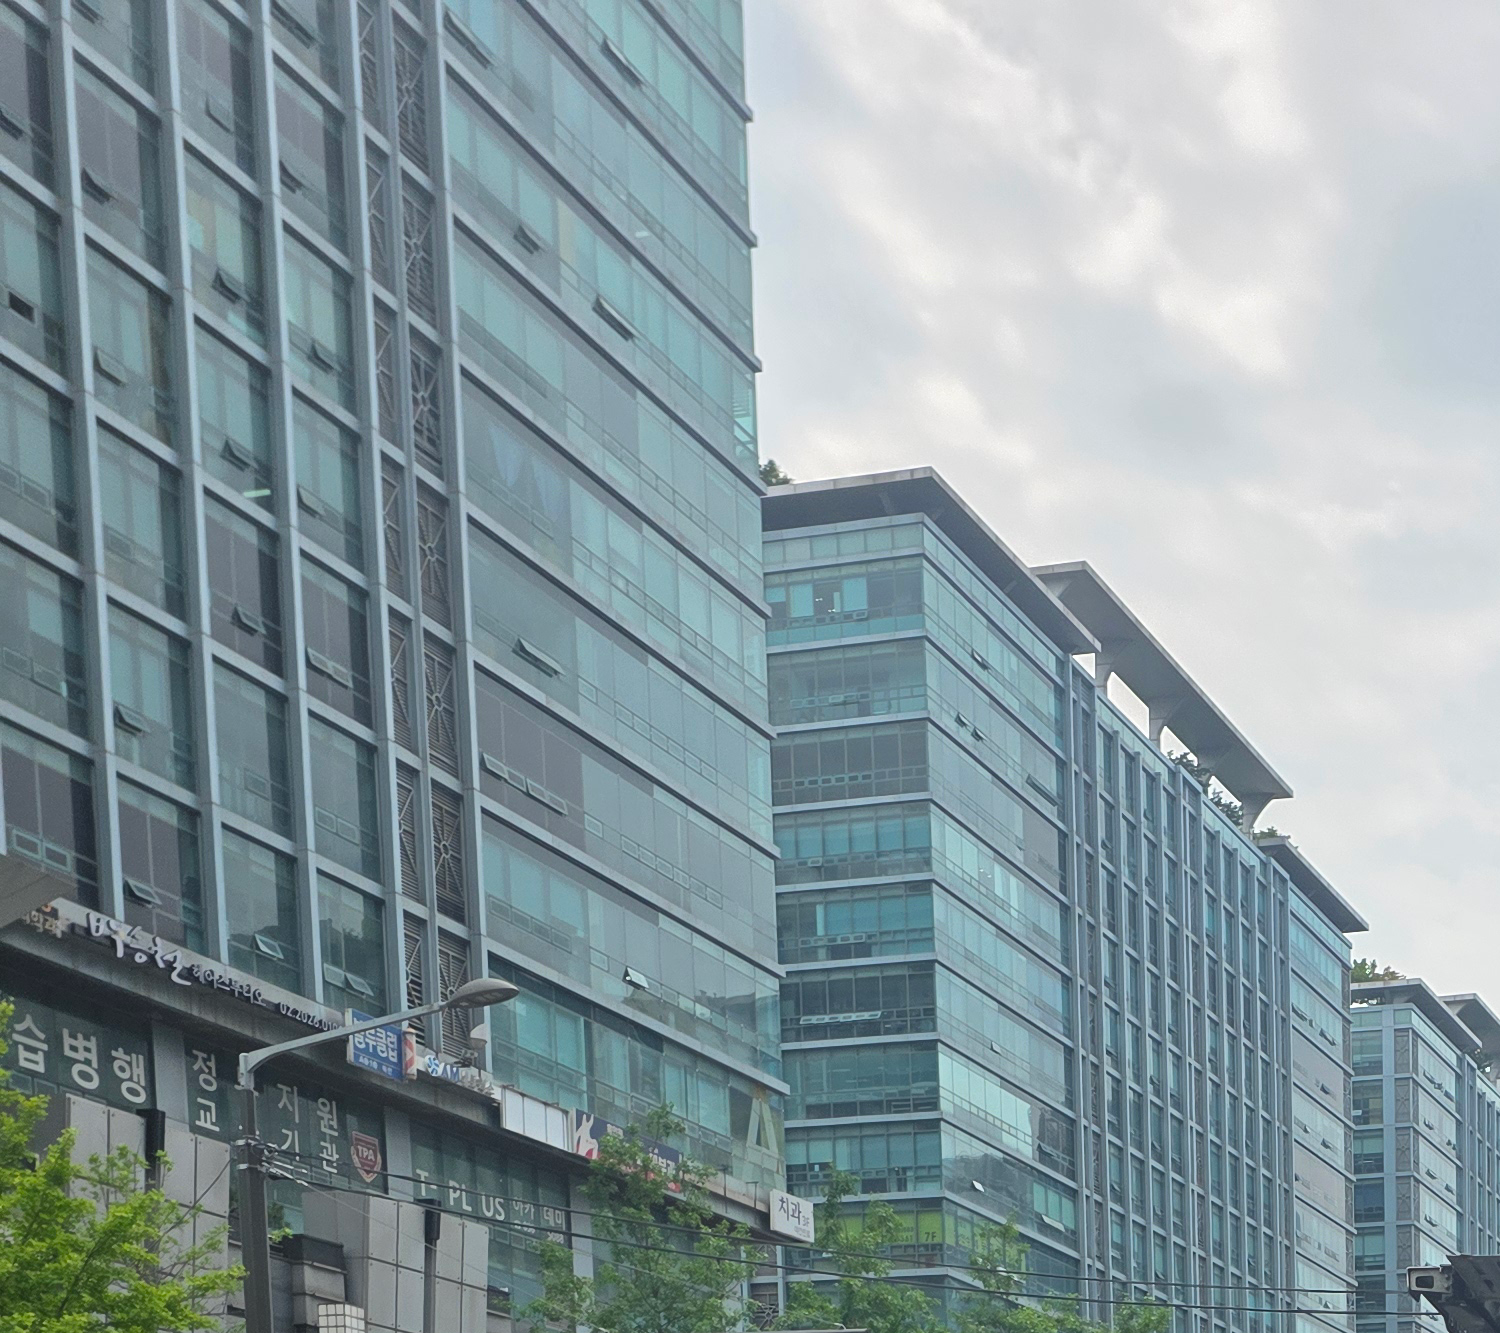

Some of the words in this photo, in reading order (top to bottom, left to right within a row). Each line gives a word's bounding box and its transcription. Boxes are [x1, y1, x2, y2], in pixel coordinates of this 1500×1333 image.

[356, 1145, 376, 1162] TPA
[778, 1196, 802, 1226] 치과
[924, 1231, 937, 1243] 7F
